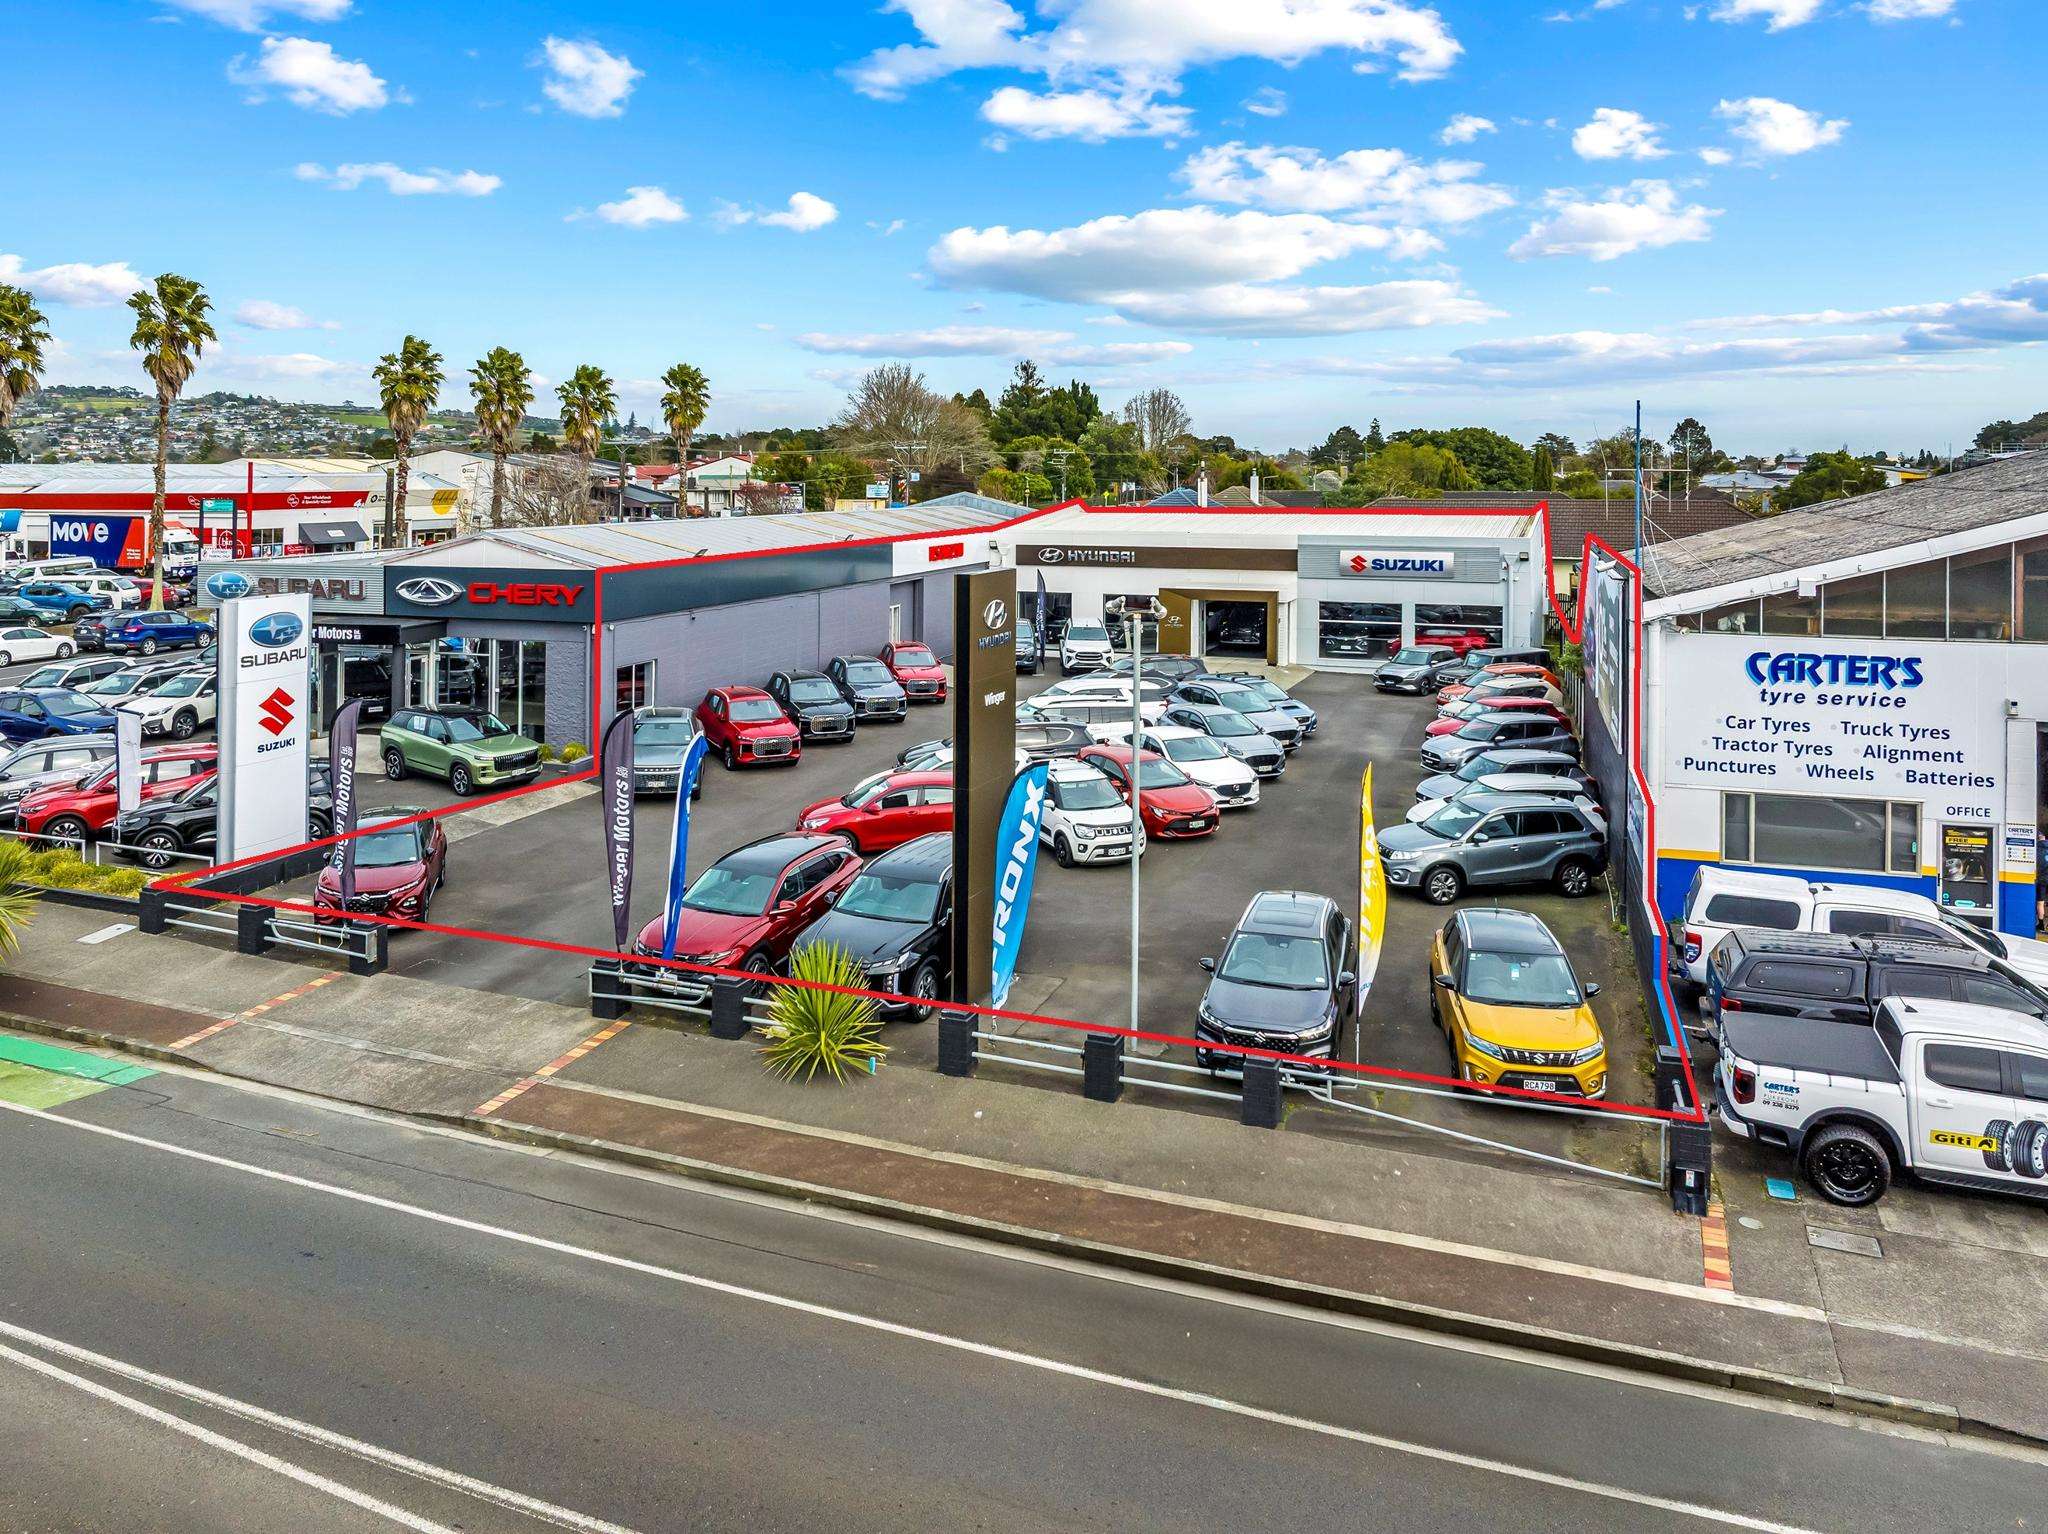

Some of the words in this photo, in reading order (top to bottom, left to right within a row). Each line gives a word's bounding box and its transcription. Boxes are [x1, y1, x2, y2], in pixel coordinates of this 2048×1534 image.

[1067, 549, 1135, 563] HYUNDAI
[1371, 558, 1444, 572] SUZUKI
[257, 577, 365, 601] SUBARU
[467, 582, 585, 606] CHERY
[319, 627, 353, 640] Motors
[978, 630, 1013, 650] HYUNDAI
[240, 647, 307, 668] SUBARU
[1744, 652, 1924, 690] CARTER'S
[984, 690, 1006, 707] Winger
[1760, 687, 1806, 706] tyre
[1816, 690, 1907, 709] service
[1725, 715, 1756, 730] Car
[1761, 717, 1811, 735] Tyres
[1841, 721, 1893, 738] Truck
[1899, 724, 1951, 742] Tyres
[257, 737, 295, 753] SUZUKI
[1712, 736, 1778, 754] Tractor
[1784, 740, 1833, 758] Tyres
[1863, 744, 1964, 764] Alignment
[1683, 757, 1777, 776] Punctures
[1806, 764, 1875, 781] Wheels
[336, 757, 353, 818] Motors
[1905, 769, 1995, 788] Batteries
[613, 779, 630, 845] Motors
[1946, 805, 1991, 818] OFFICE
[1525, 1081, 1554, 1090] RCA798
[1934, 1132, 1972, 1147] Giti
